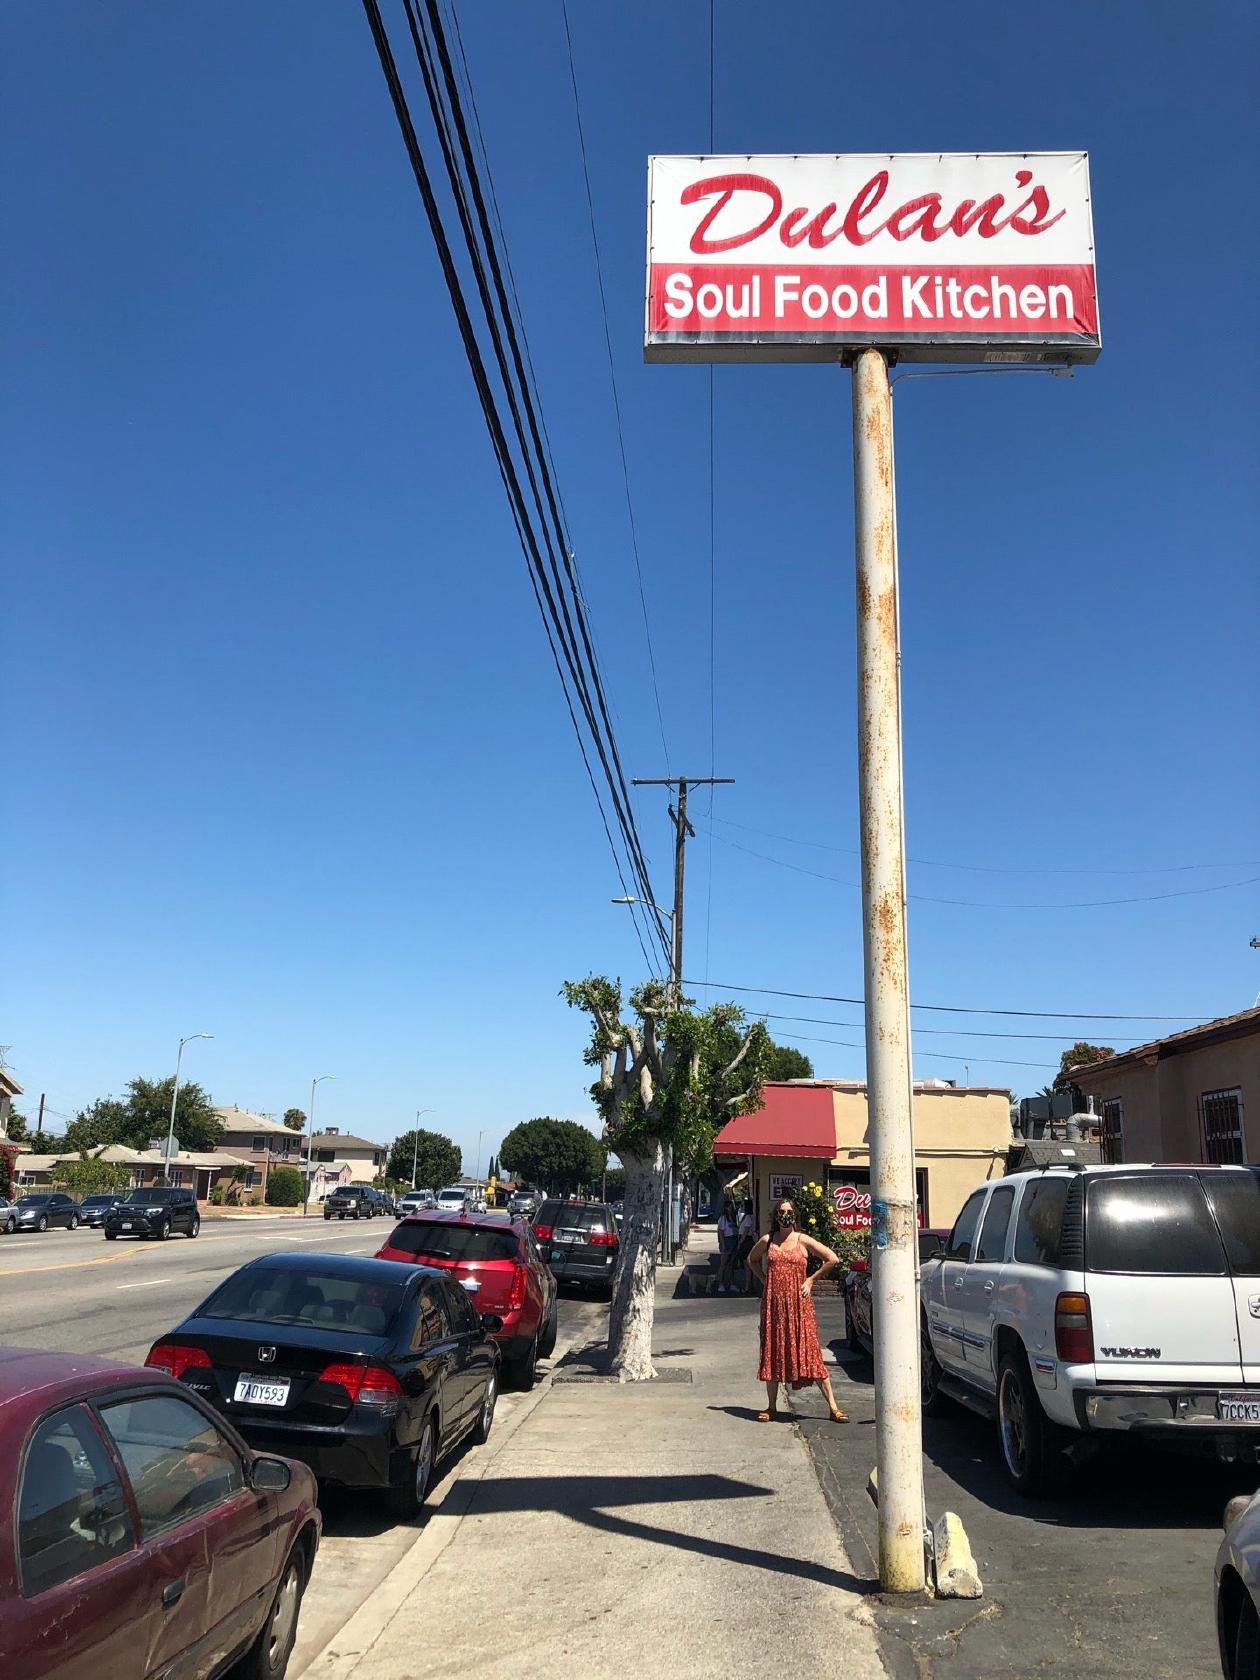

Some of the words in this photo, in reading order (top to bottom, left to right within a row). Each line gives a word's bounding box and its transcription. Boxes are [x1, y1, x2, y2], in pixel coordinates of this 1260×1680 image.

[680, 170, 1066, 254] Dulan's
[664, 273, 761, 319] Soul
[774, 275, 888, 319] Food
[902, 275, 1074, 319] Kitchen
[1100, 1347, 1161, 1359] YUKON
[1222, 1403, 1260, 1420] 7CCK5
